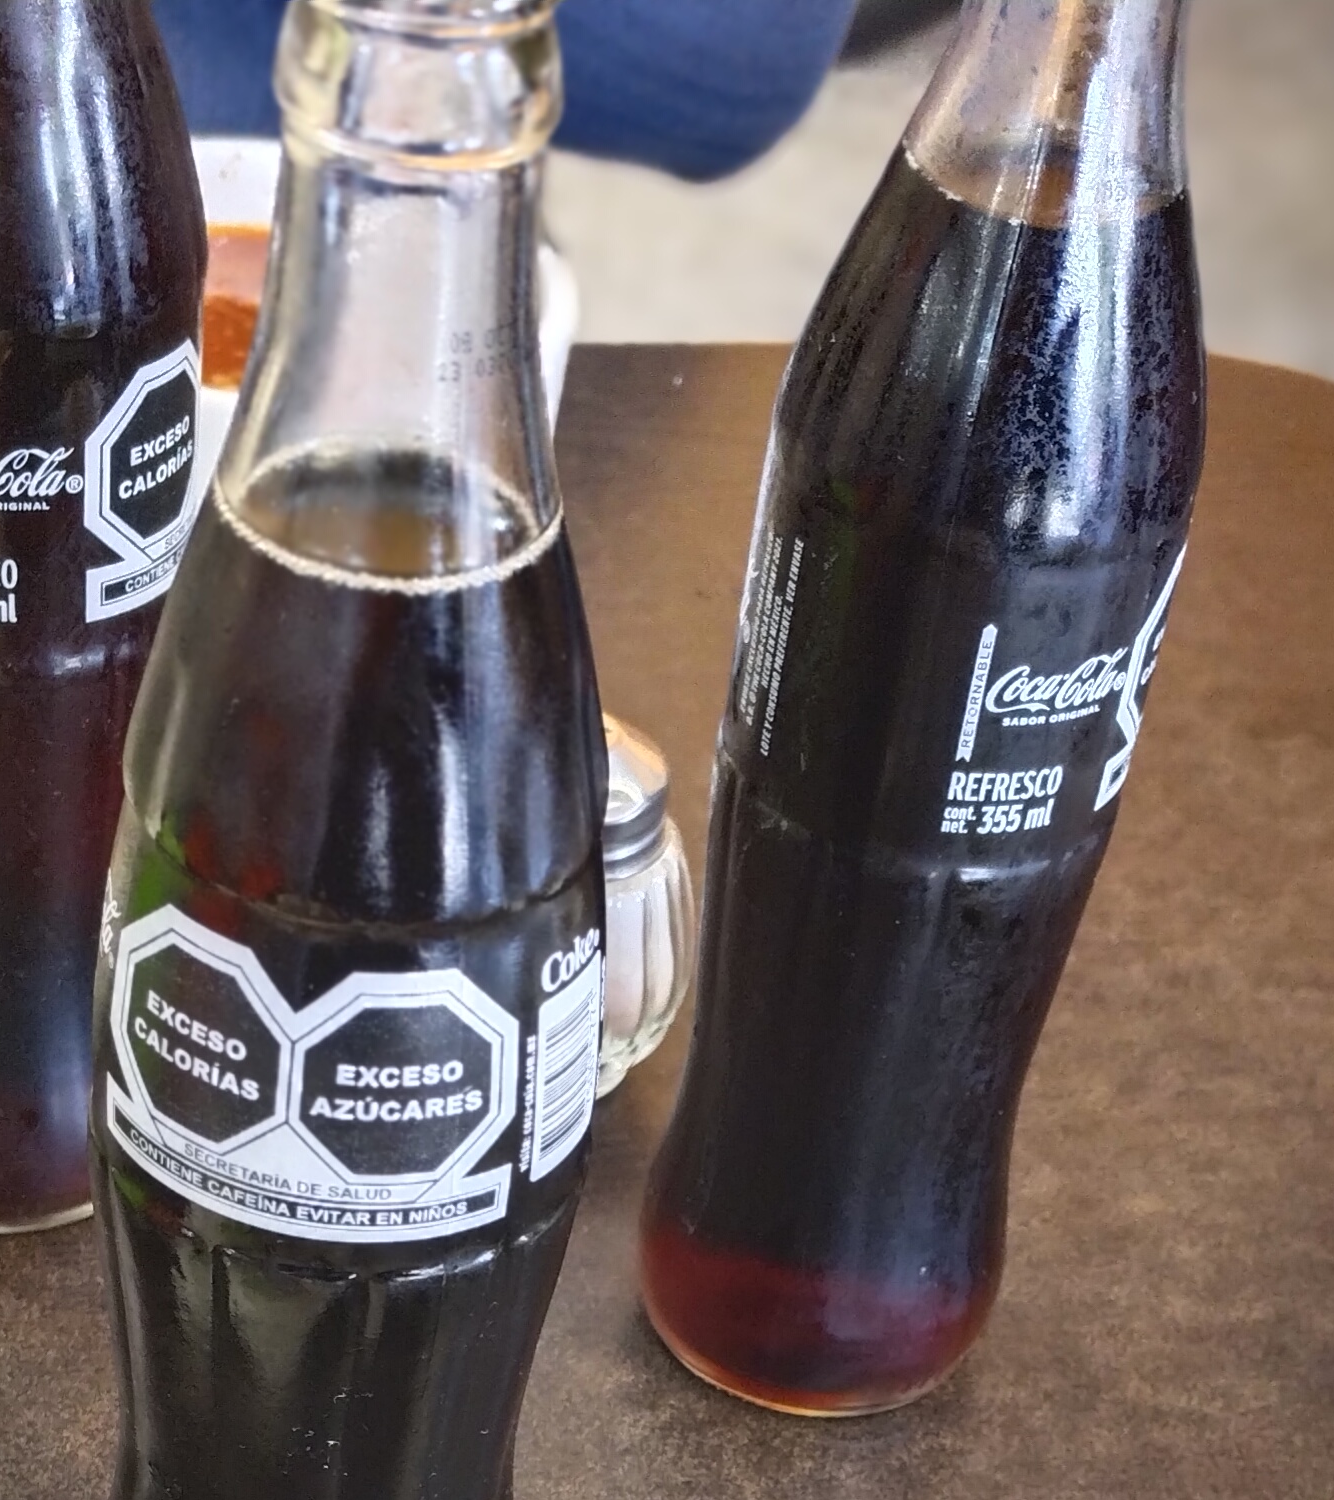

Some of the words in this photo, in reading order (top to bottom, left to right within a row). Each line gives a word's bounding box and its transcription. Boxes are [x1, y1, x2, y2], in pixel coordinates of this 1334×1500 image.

[130, 415, 191, 467] EXCESO
[118, 440, 194, 499] CALORÍAS
[125, 557, 176, 593] CONTIENE
[789, 537, 805, 581] ENVASE
[785, 580, 796, 603] VER
[766, 671, 781, 722] CONSUMO
[961, 640, 992, 748] RETORNABLE
[1002, 713, 1046, 727] SABOR
[1049, 704, 1100, 723] ORIGINAL
[760, 729, 771, 756] LOTE
[947, 765, 1064, 802] REFRESCO
[940, 819, 968, 834] net.
[943, 805, 976, 820] cont.
[977, 803, 1023, 835] 355
[1023, 798, 1055, 830] ml
[146, 989, 247, 1061] EXCESO
[134, 1016, 260, 1101] CALORÍAS
[335, 1059, 464, 1089] EXCESO
[309, 1090, 484, 1122] AZÚCARES
[130, 1128, 204, 1188] CONTIENE
[207, 1179, 290, 1217] CAFEÍNA
[296, 1207, 371, 1226] EVITAR
[376, 1211, 403, 1226] EN
[409, 1201, 468, 1222] NIÑOS
[184, 1142, 292, 1191] SECRETARÍA
[296, 1180, 323, 1196] DE
[327, 1184, 392, 1201] SALUD
